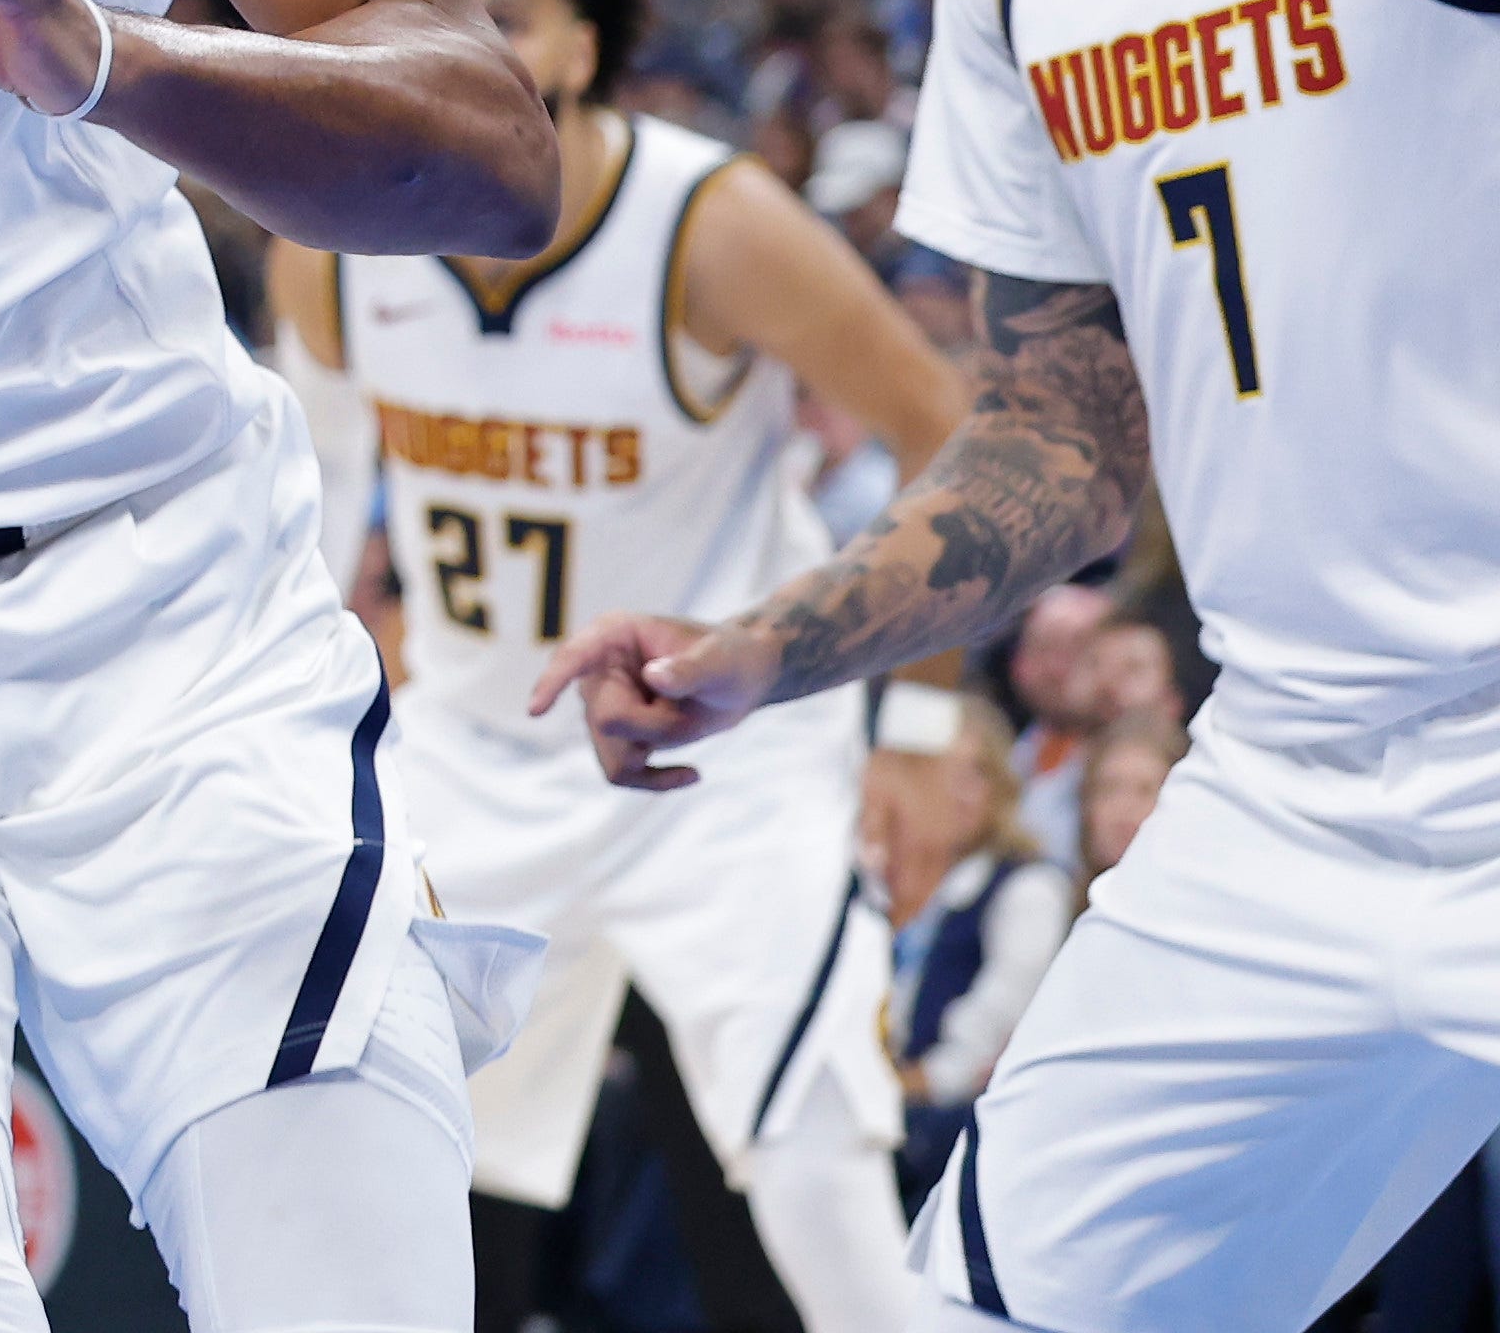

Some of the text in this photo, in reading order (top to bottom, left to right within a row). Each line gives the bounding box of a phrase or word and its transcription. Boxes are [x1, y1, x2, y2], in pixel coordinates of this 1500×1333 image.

[1153, 161, 1263, 402] 7
[374, 401, 642, 487] NUGGETS
[426, 503, 574, 643] 27
